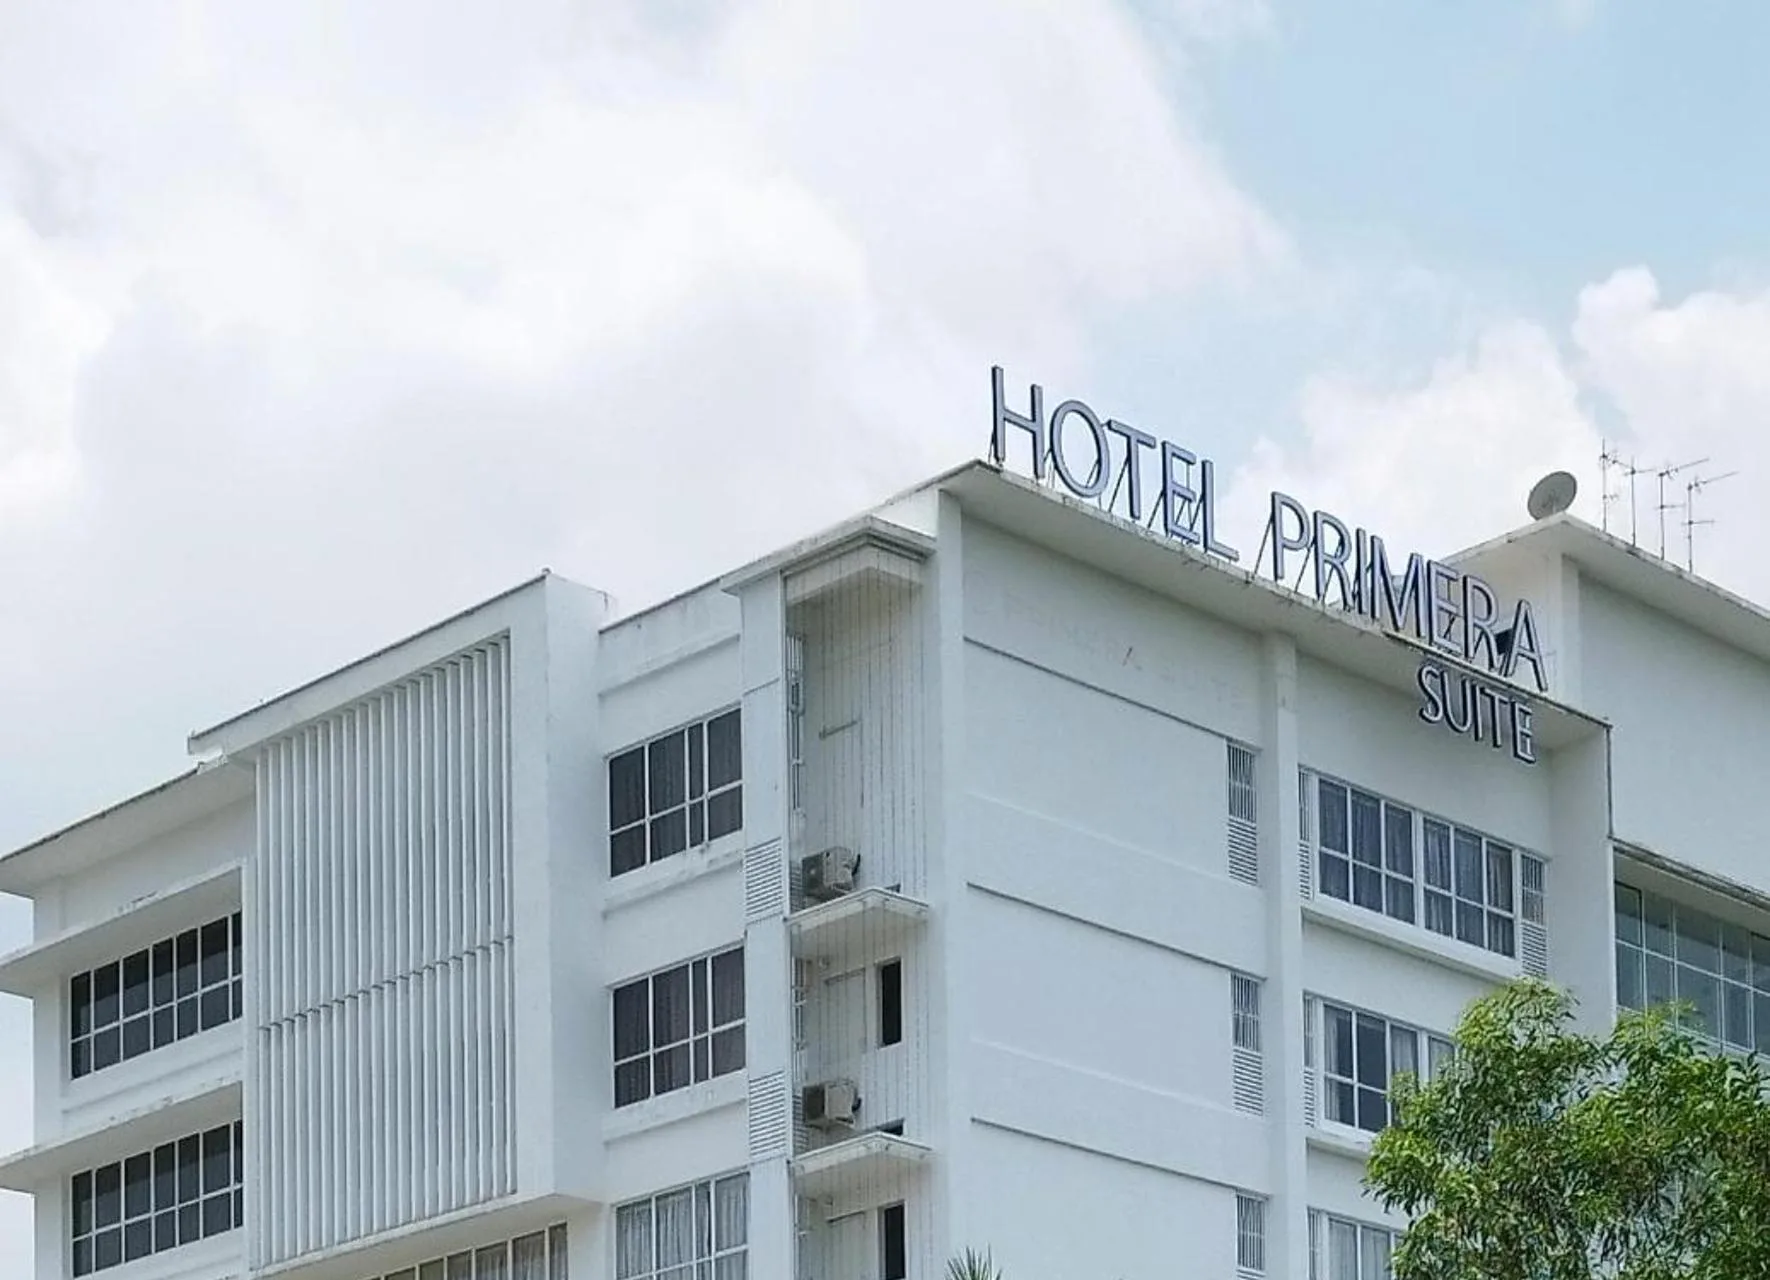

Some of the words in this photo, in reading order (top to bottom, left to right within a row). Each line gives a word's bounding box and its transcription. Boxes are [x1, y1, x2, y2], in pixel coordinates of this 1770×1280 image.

[990, 364, 1239, 563] HOTEL
[1270, 490, 1549, 693] PRIMERA
[1418, 660, 1537, 765] SUITE
